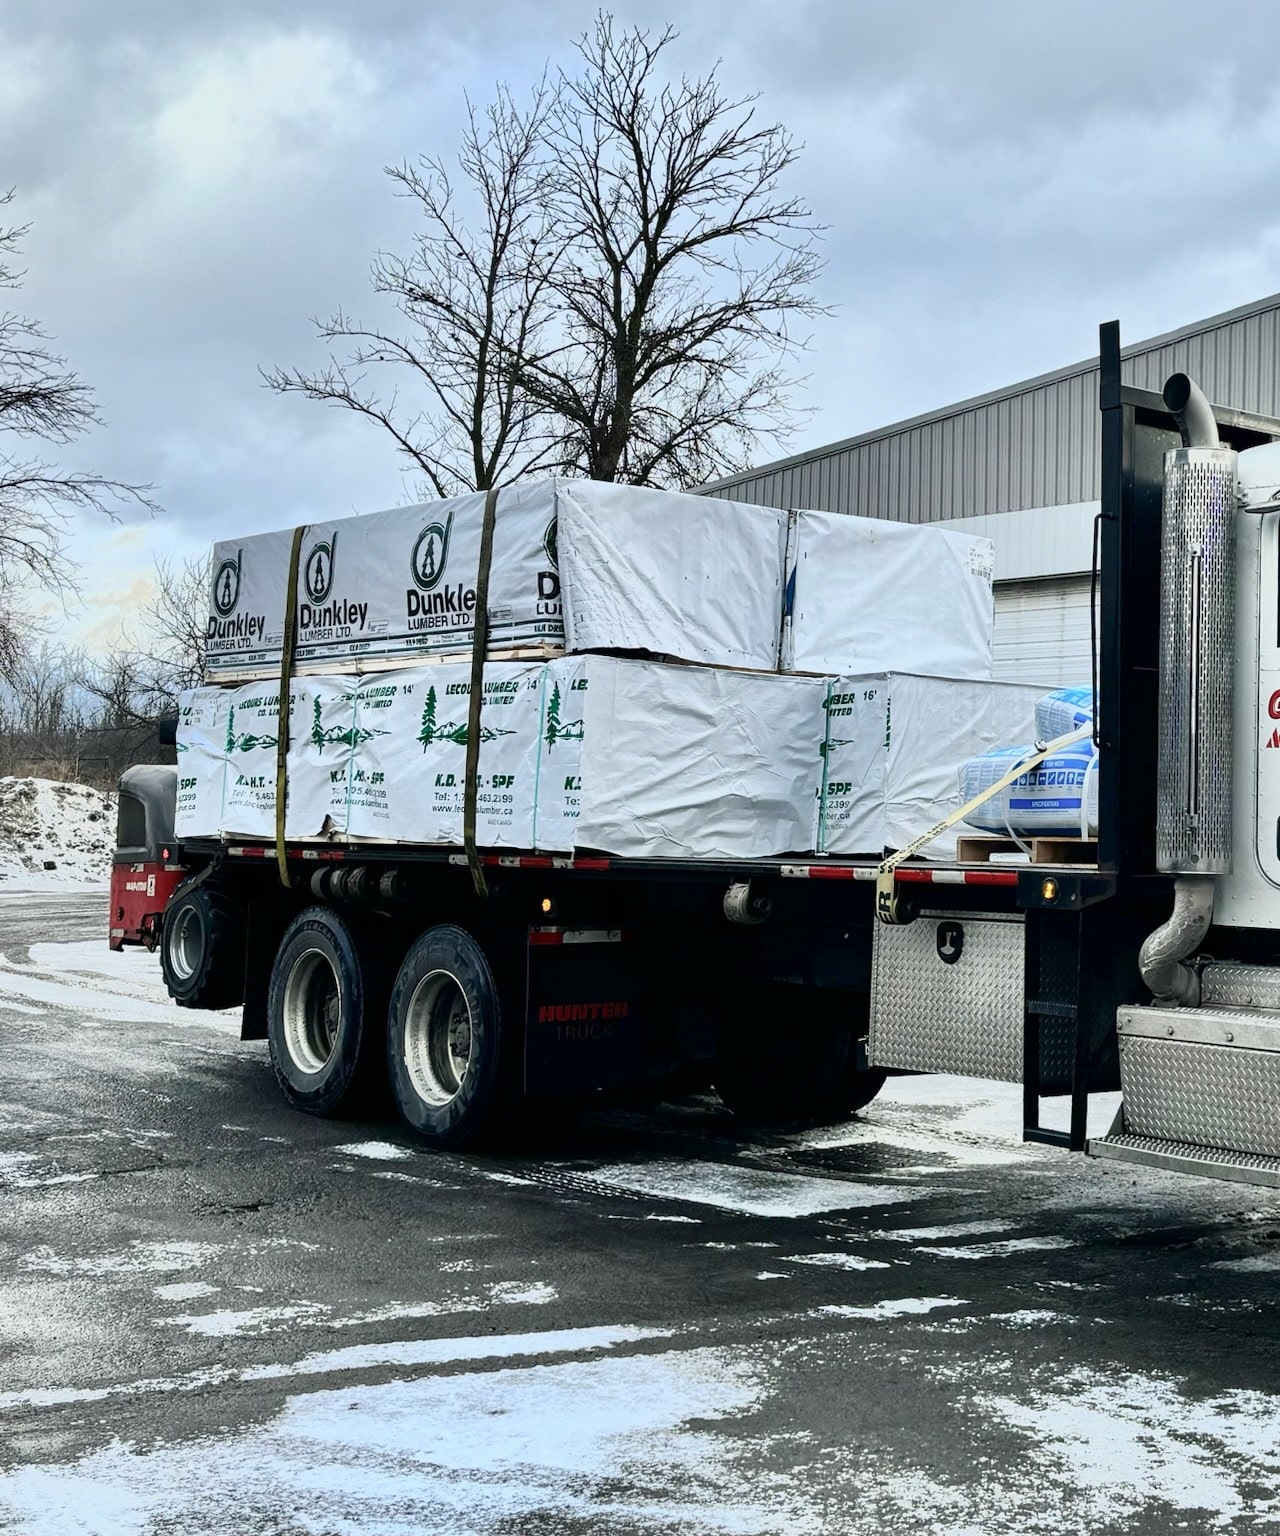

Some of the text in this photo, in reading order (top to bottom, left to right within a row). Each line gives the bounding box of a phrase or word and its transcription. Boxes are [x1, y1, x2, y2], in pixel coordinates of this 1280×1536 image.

[407, 583, 477, 616] Dunkle
[300, 599, 368, 631] Dunkley
[407, 615, 448, 631] LUMBER
[451, 612, 473, 626] LTD.
[207, 612, 266, 641] Dunkley
[300, 628, 334, 642] LUMBER
[335, 626, 353, 639] LTD.
[237, 637, 254, 649] LTD.
[366, 686, 397, 699] LUMBER
[484, 681, 519, 693] LUMBER
[863, 690, 877, 701] 16'
[434, 774, 457, 787] K.D.
[492, 774, 515, 788] SPF
[827, 782, 852, 795] SPF
[434, 792, 450, 801] Tel:
[538, 1002, 628, 1023] HUNTER
